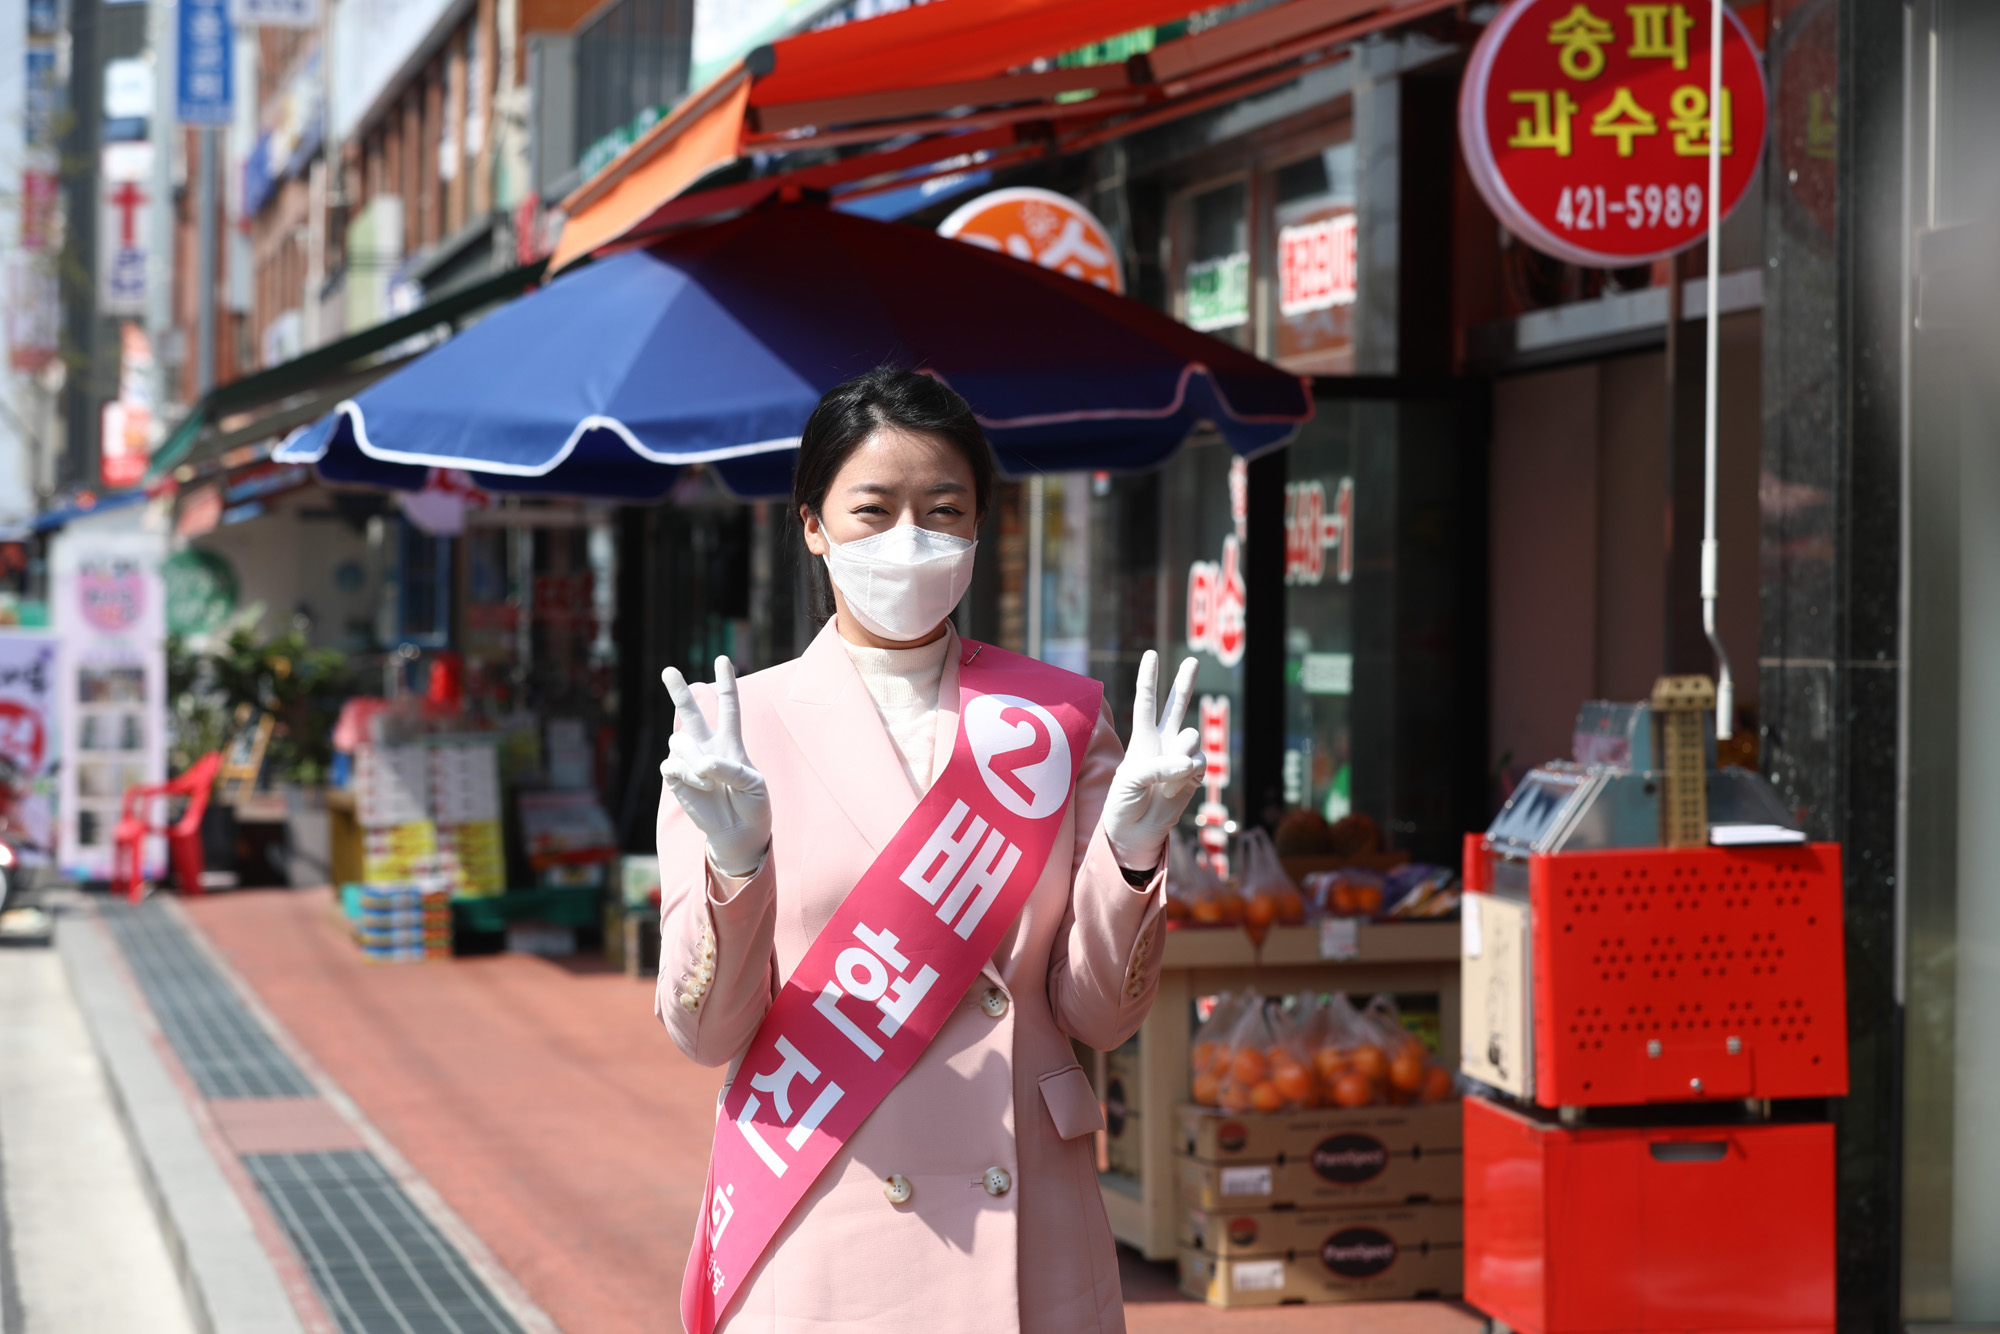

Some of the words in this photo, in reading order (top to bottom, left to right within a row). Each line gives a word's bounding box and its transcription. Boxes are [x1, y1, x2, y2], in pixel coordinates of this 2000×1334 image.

[1548, 4, 1695, 81] 송파
[1508, 84, 1733, 157] 과수원
[1556, 183, 1703, 229] 421-5989
[987, 705, 1052, 807] 2
[736, 798, 1023, 1179] 배현진
